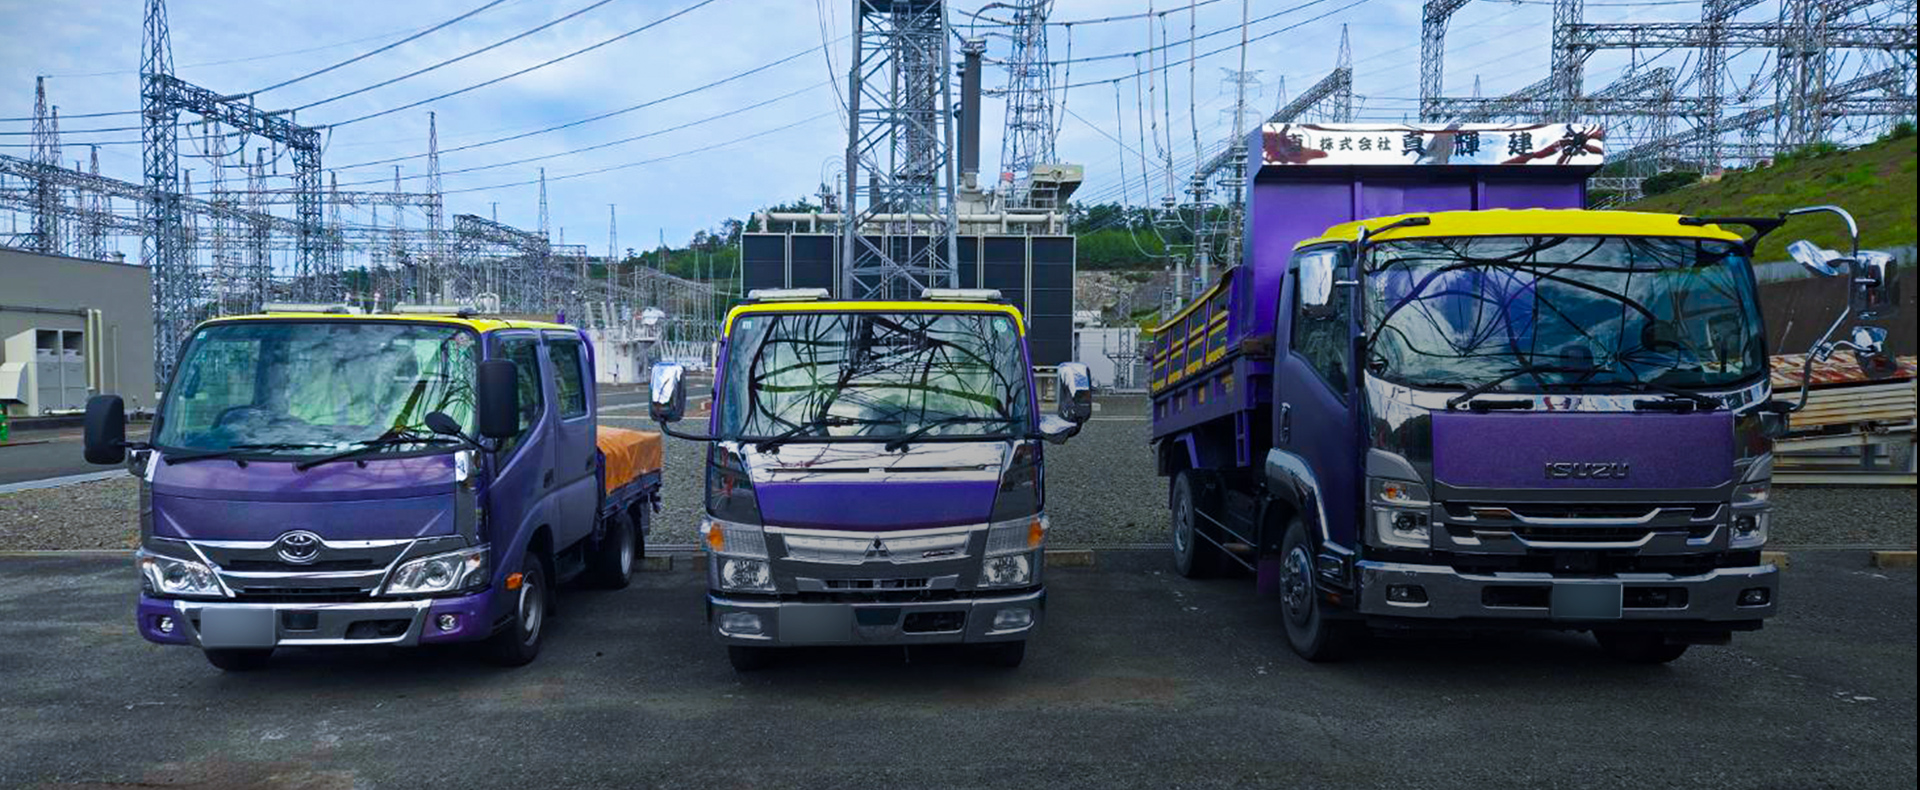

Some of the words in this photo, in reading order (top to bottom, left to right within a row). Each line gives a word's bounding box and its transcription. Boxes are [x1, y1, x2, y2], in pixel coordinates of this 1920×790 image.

[1319, 136, 1392, 151] 株式会社
[1545, 462, 1629, 479] ISUZU
